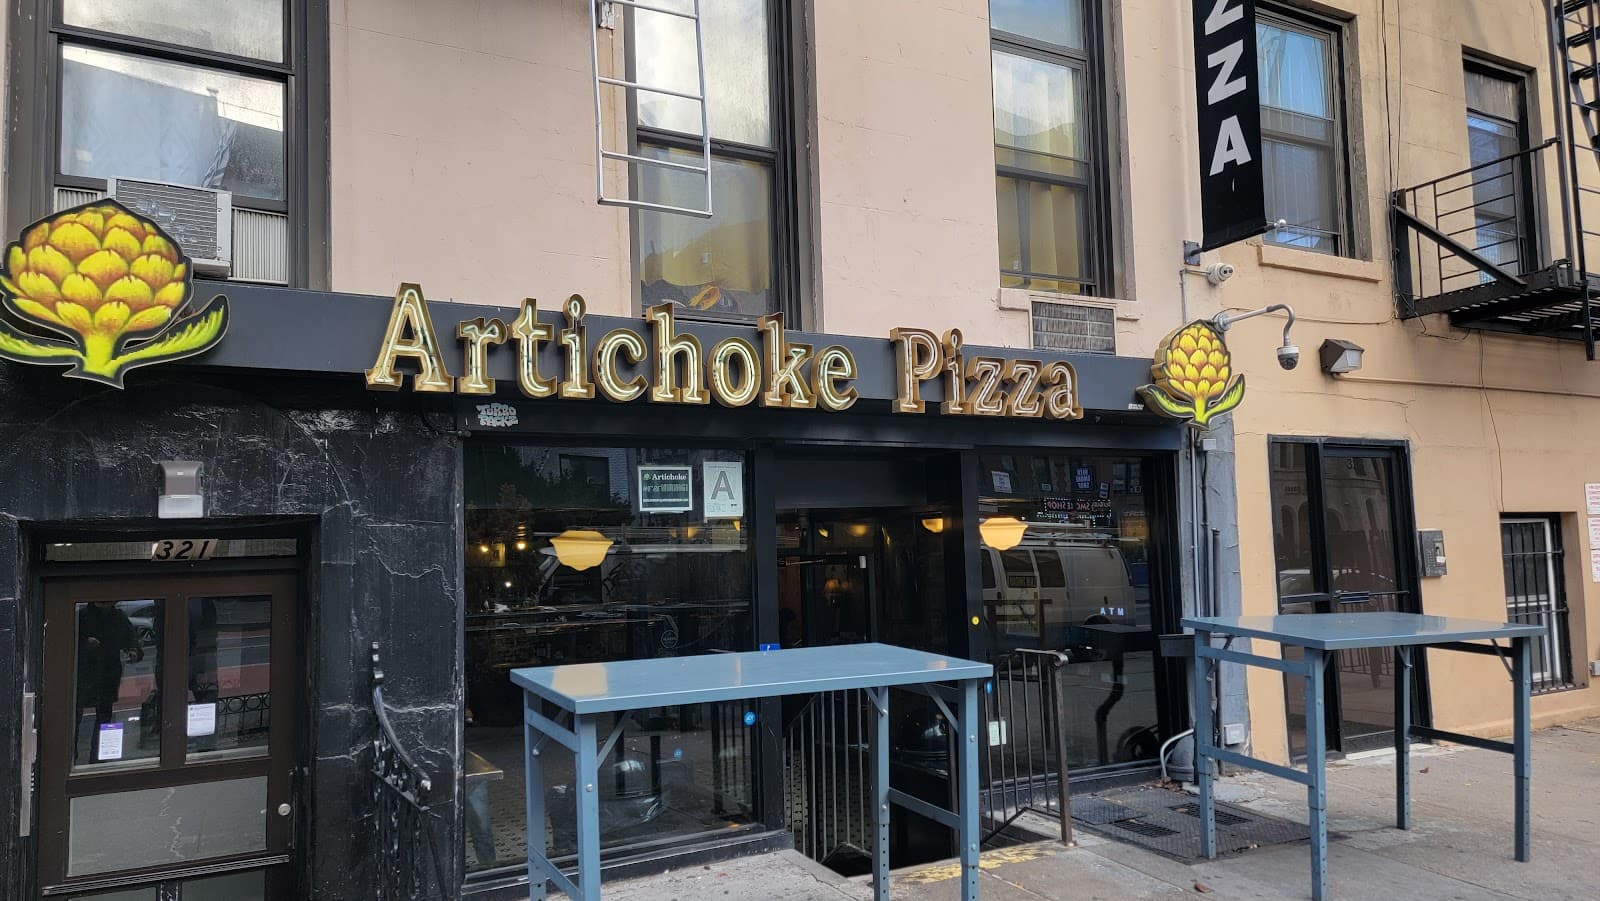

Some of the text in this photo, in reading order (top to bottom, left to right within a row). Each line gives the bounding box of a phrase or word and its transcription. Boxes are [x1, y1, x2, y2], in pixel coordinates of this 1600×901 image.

[365, 282, 1084, 420] Artichoke Pizza
[651, 472, 687, 481] Artichoke
[710, 470, 735, 500] A
[155, 540, 210, 559] 321
[1099, 606, 1125, 616] ATM
